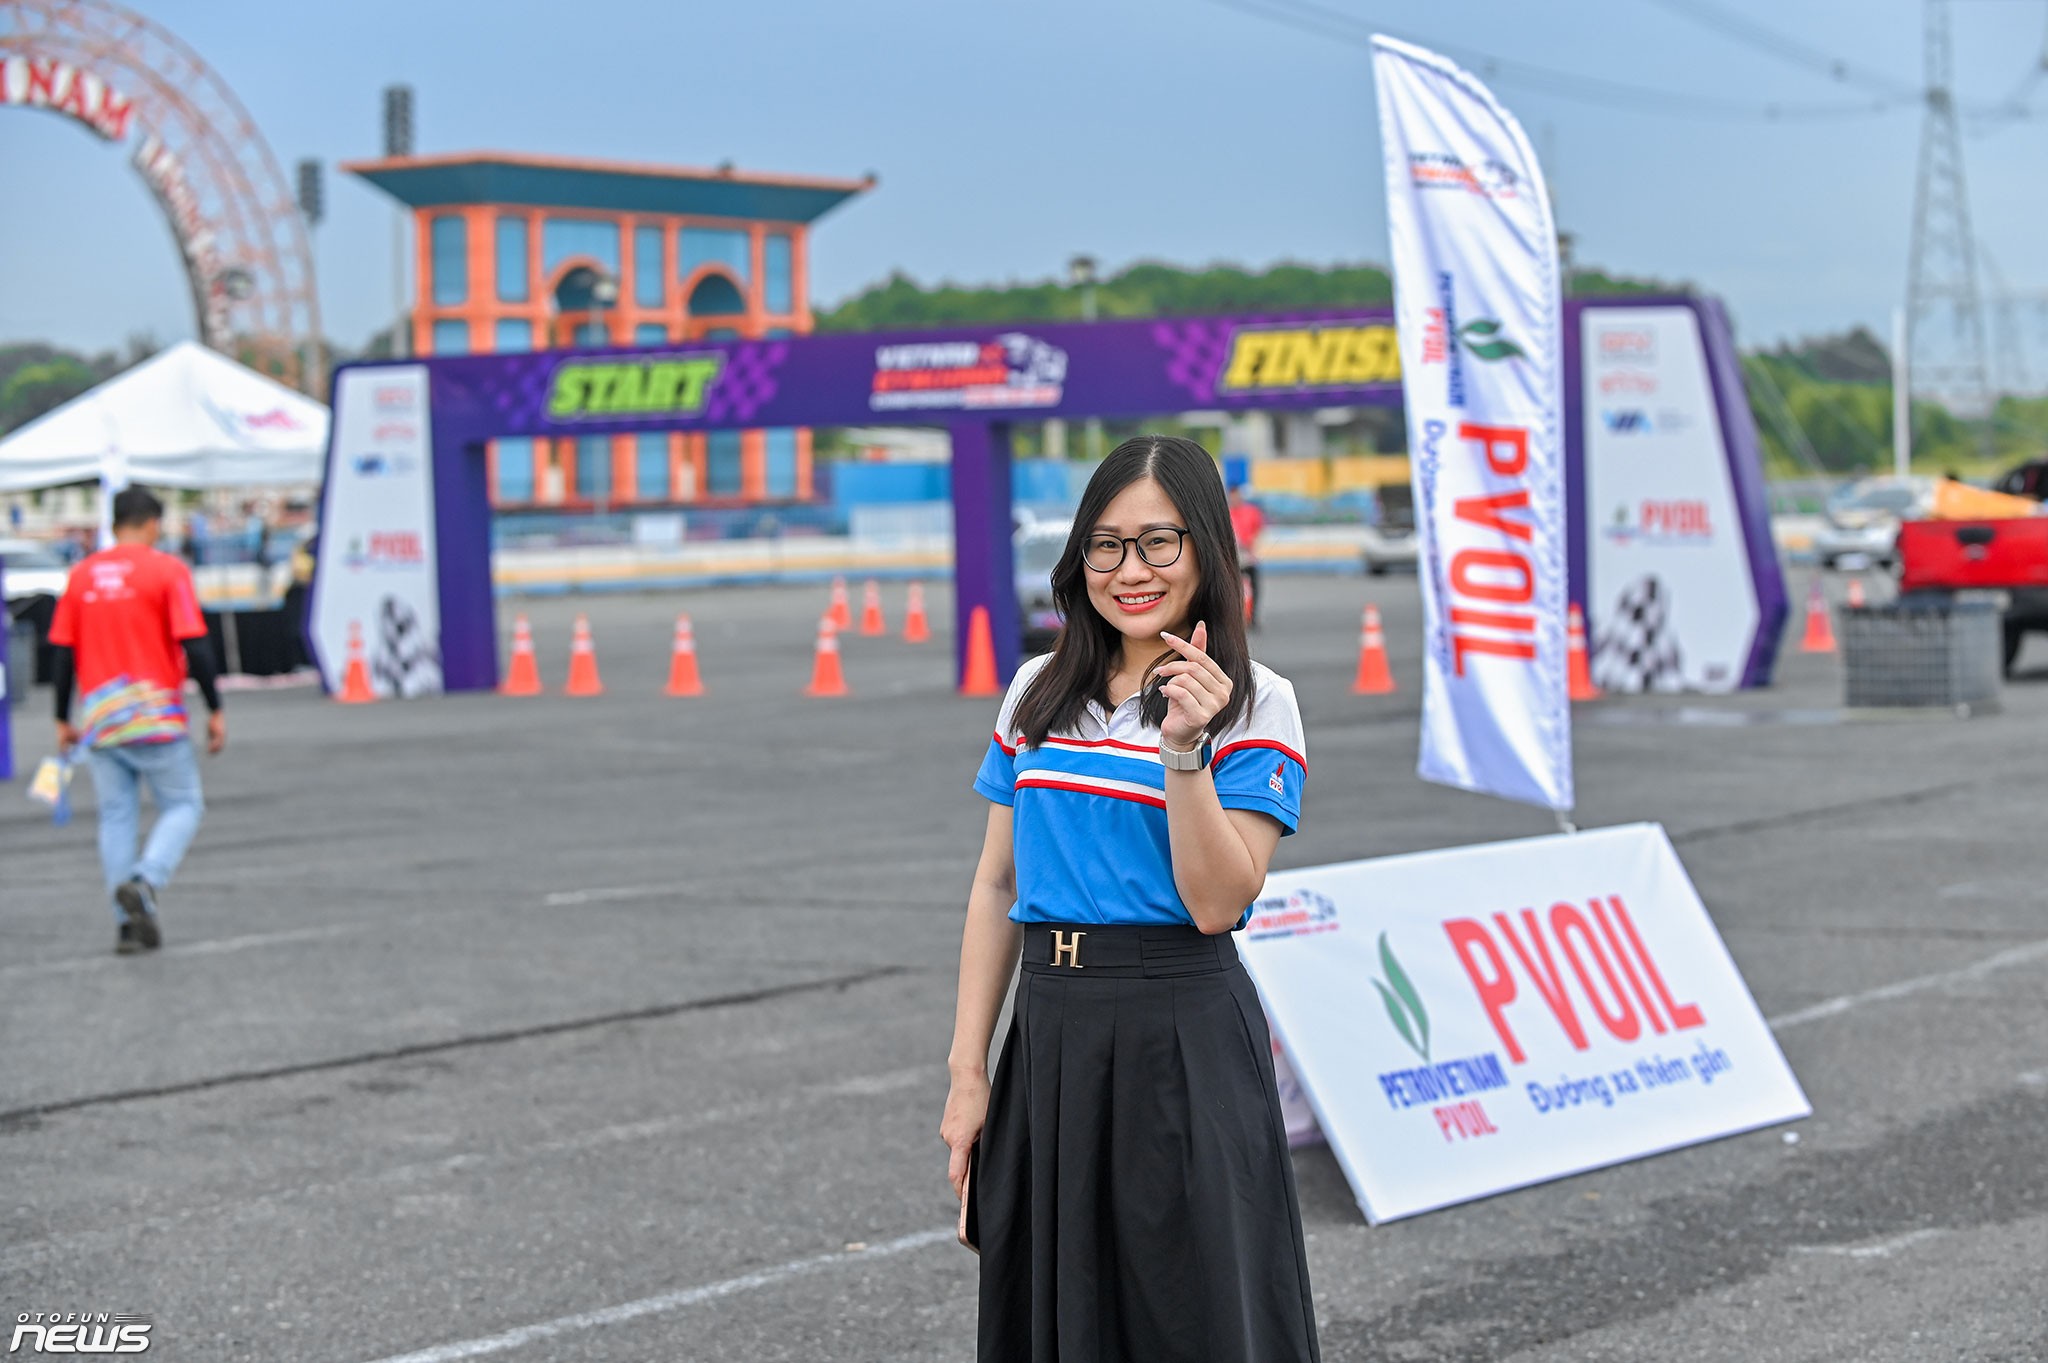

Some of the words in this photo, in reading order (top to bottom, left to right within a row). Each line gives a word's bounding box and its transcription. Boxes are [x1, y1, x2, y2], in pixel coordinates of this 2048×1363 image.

[551, 358, 718, 416] START
[1450, 422, 1537, 678] PVOIL
[1050, 930, 1087, 968] H
[1442, 895, 1706, 1065] PVOIL
[1611, 1071, 1639, 1097] xa
[1432, 1100, 1499, 1142] PVOIL
